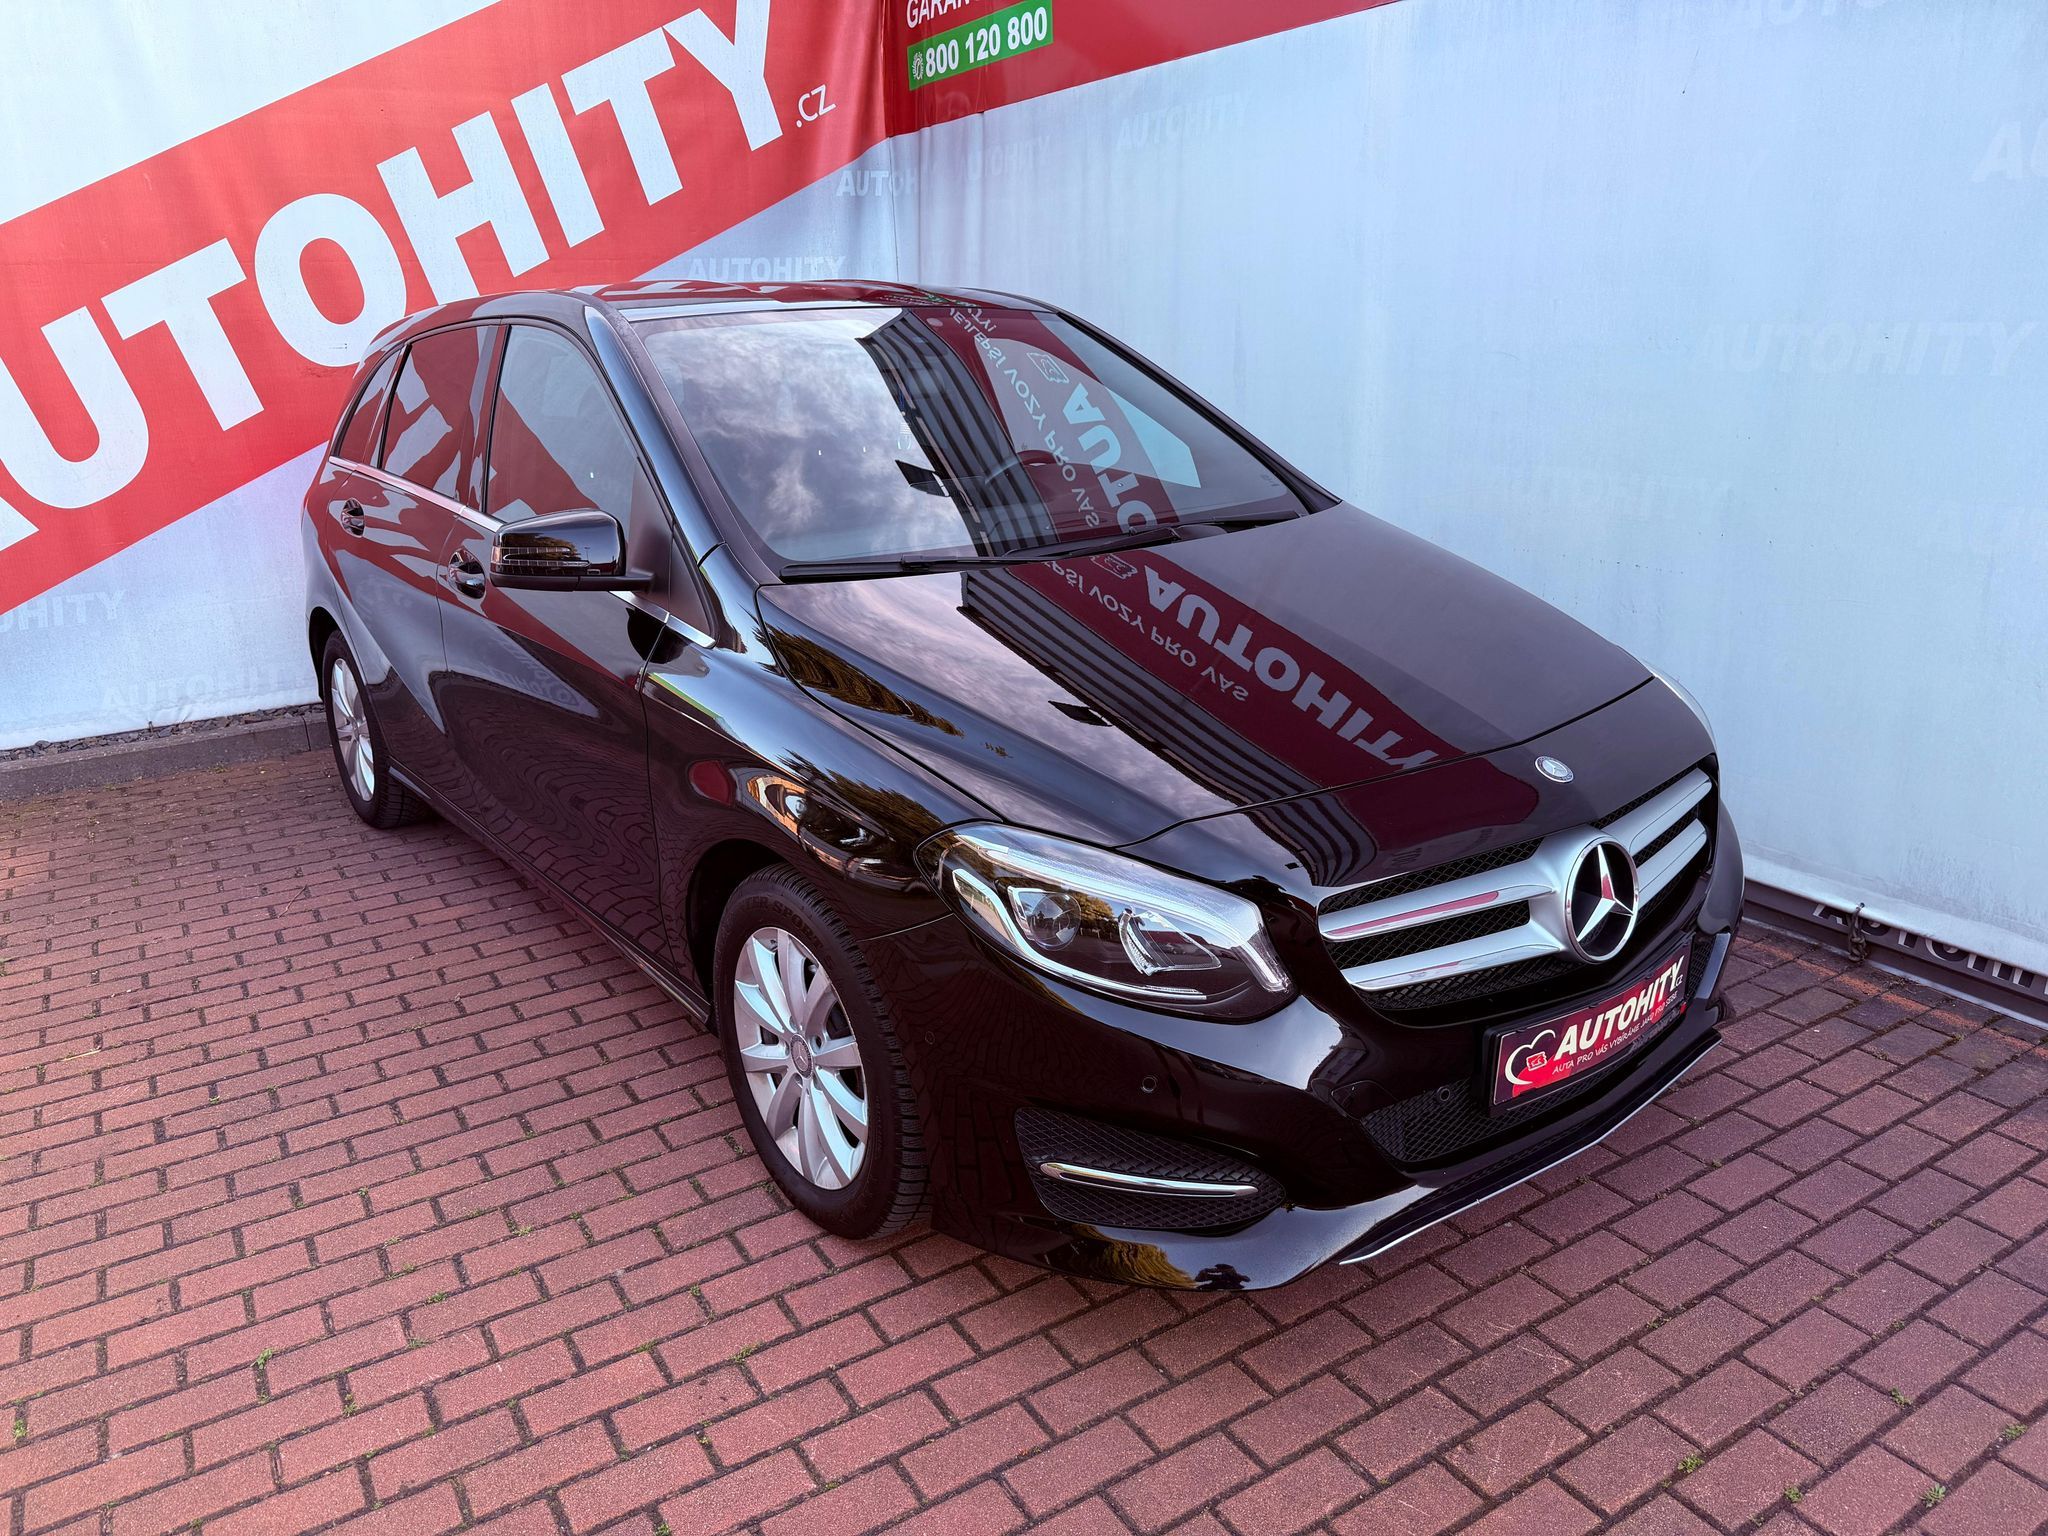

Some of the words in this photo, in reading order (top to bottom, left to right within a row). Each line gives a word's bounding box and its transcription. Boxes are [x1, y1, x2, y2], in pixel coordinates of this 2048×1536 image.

[925, 38, 959, 78] 800
[965, 24, 1001, 63] 120
[1007, 6, 1048, 50] 800
[796, 84, 836, 128] .CZ
[1553, 955, 1685, 1061] AUTOHITY
[1552, 1060, 1574, 1075] AUTA
[1576, 1051, 1594, 1066] PRO
